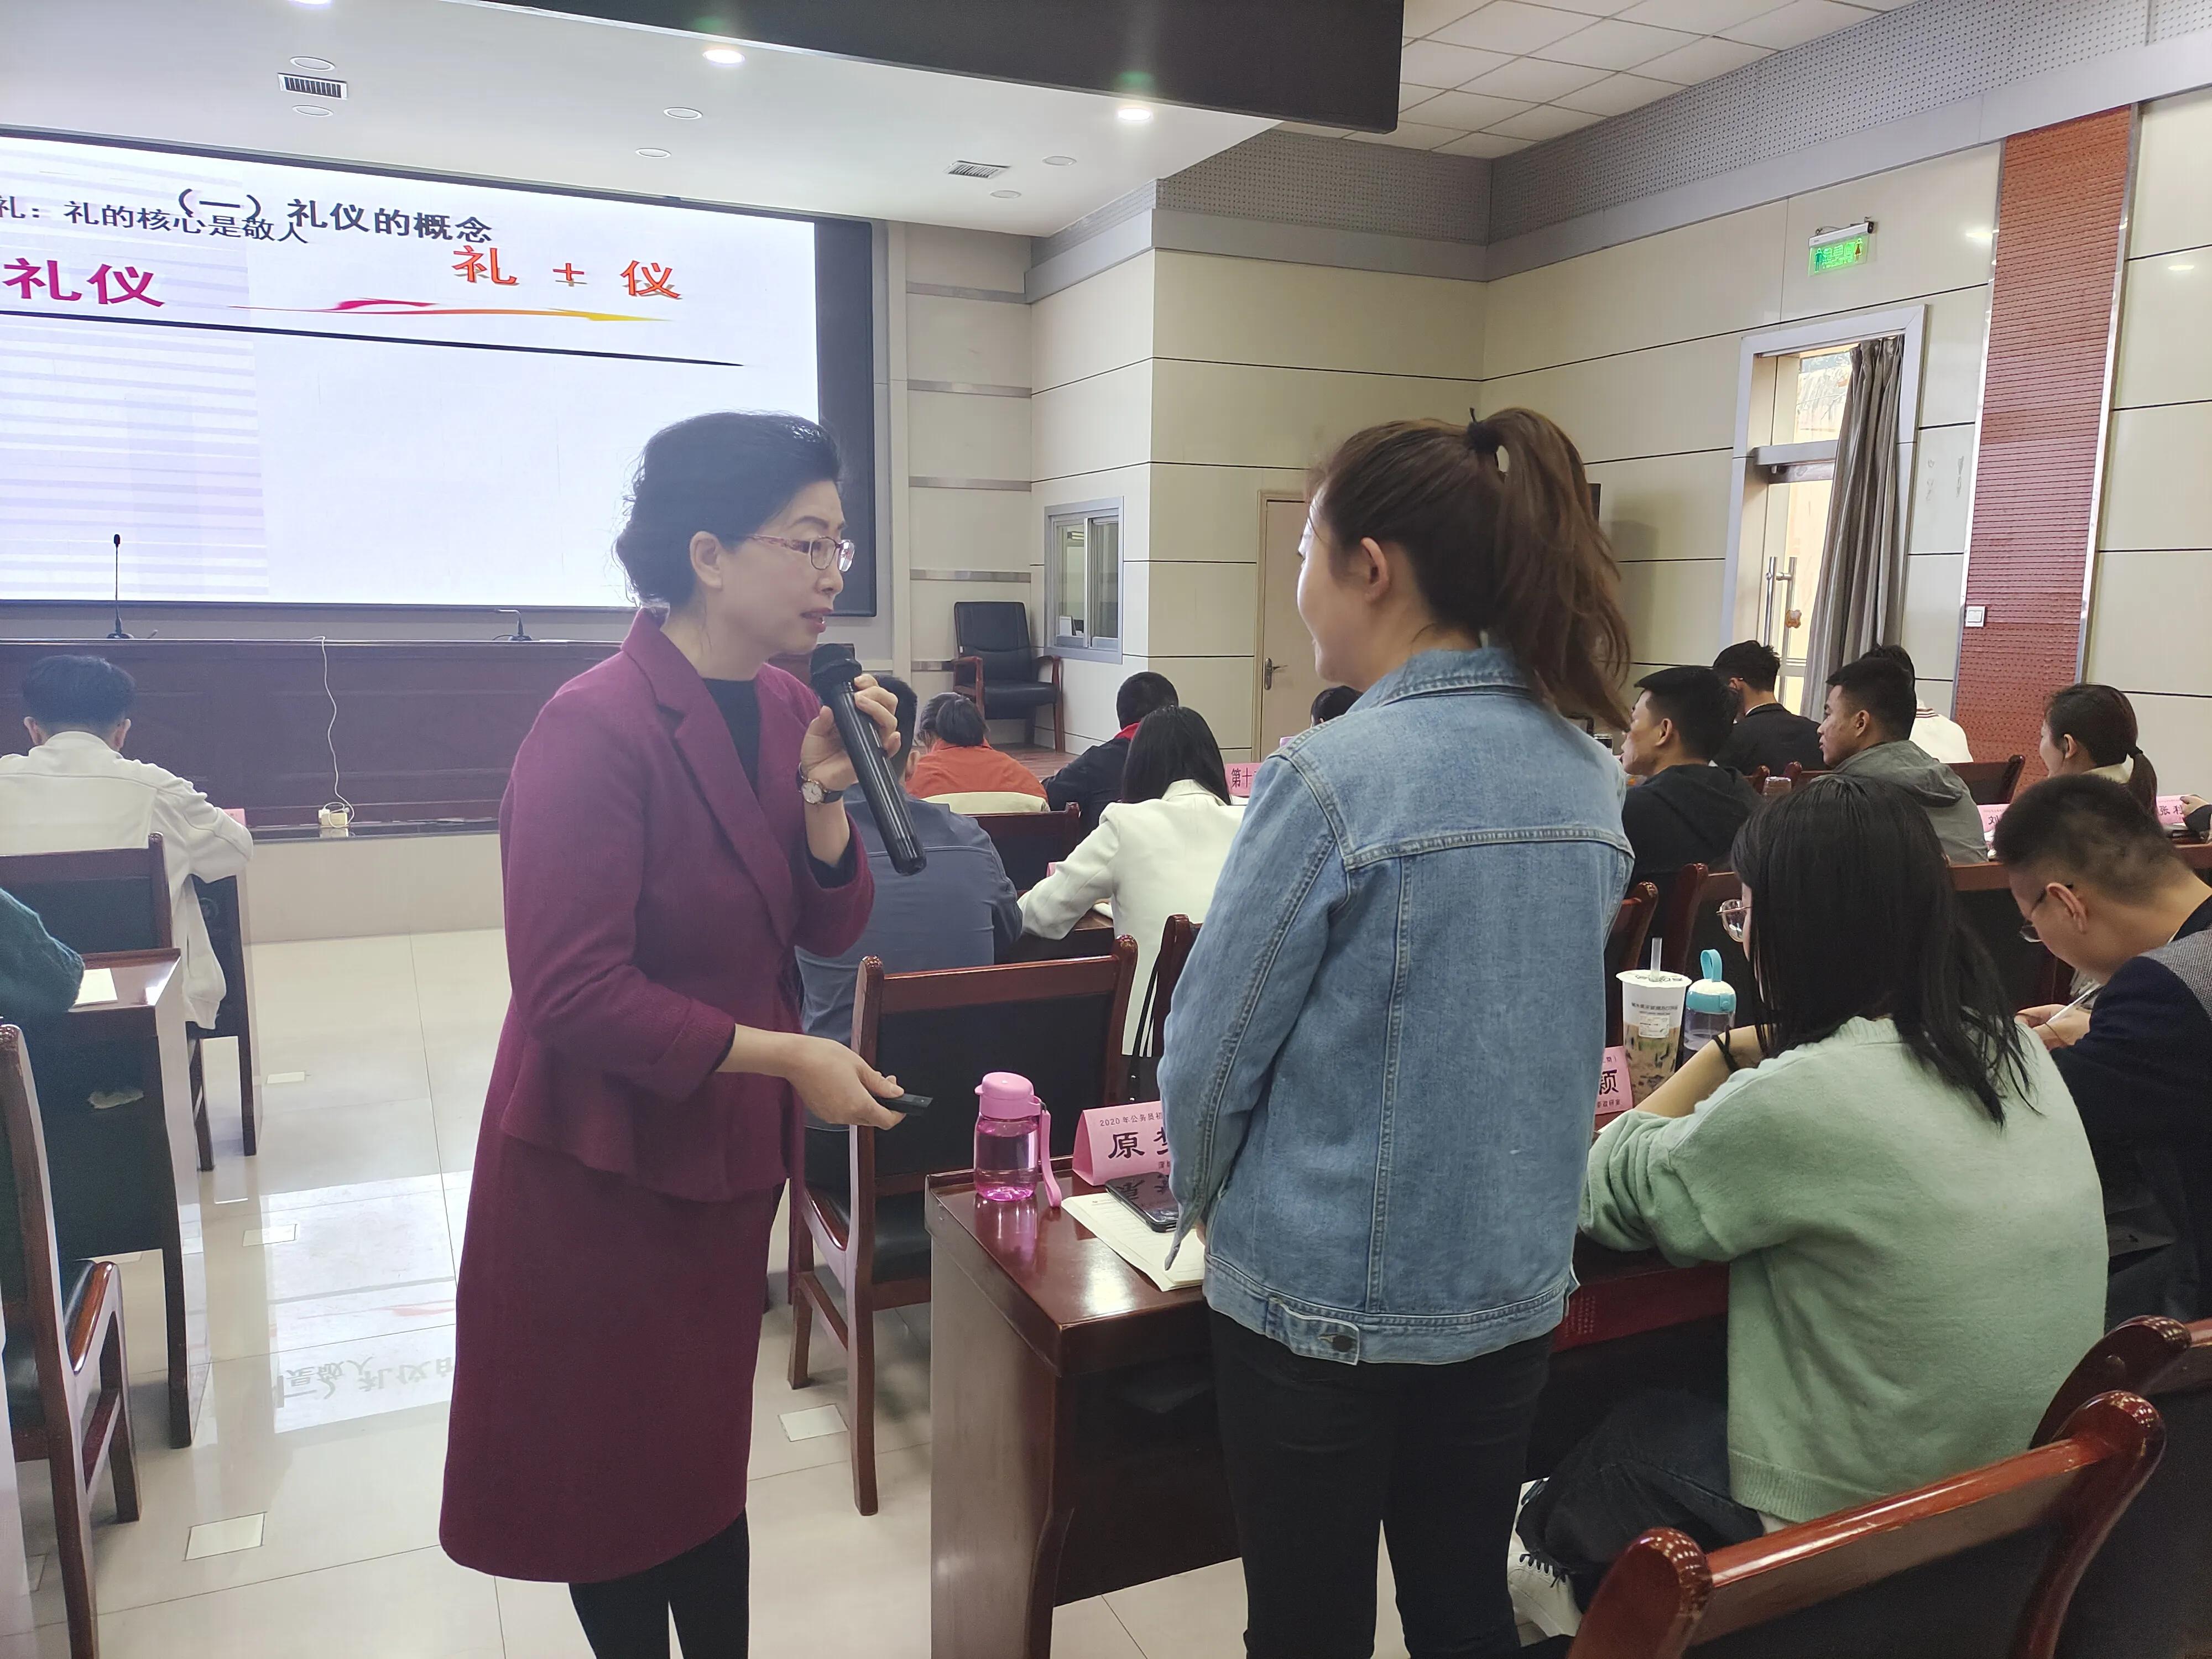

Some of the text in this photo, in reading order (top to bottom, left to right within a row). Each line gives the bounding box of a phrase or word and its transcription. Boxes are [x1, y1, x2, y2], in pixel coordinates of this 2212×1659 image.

[2, 257, 165, 307] 礼仪
[451, 245, 518, 284] 礼
[620, 260, 681, 299] 仪
[1231, 768, 1258, 789] 第十
